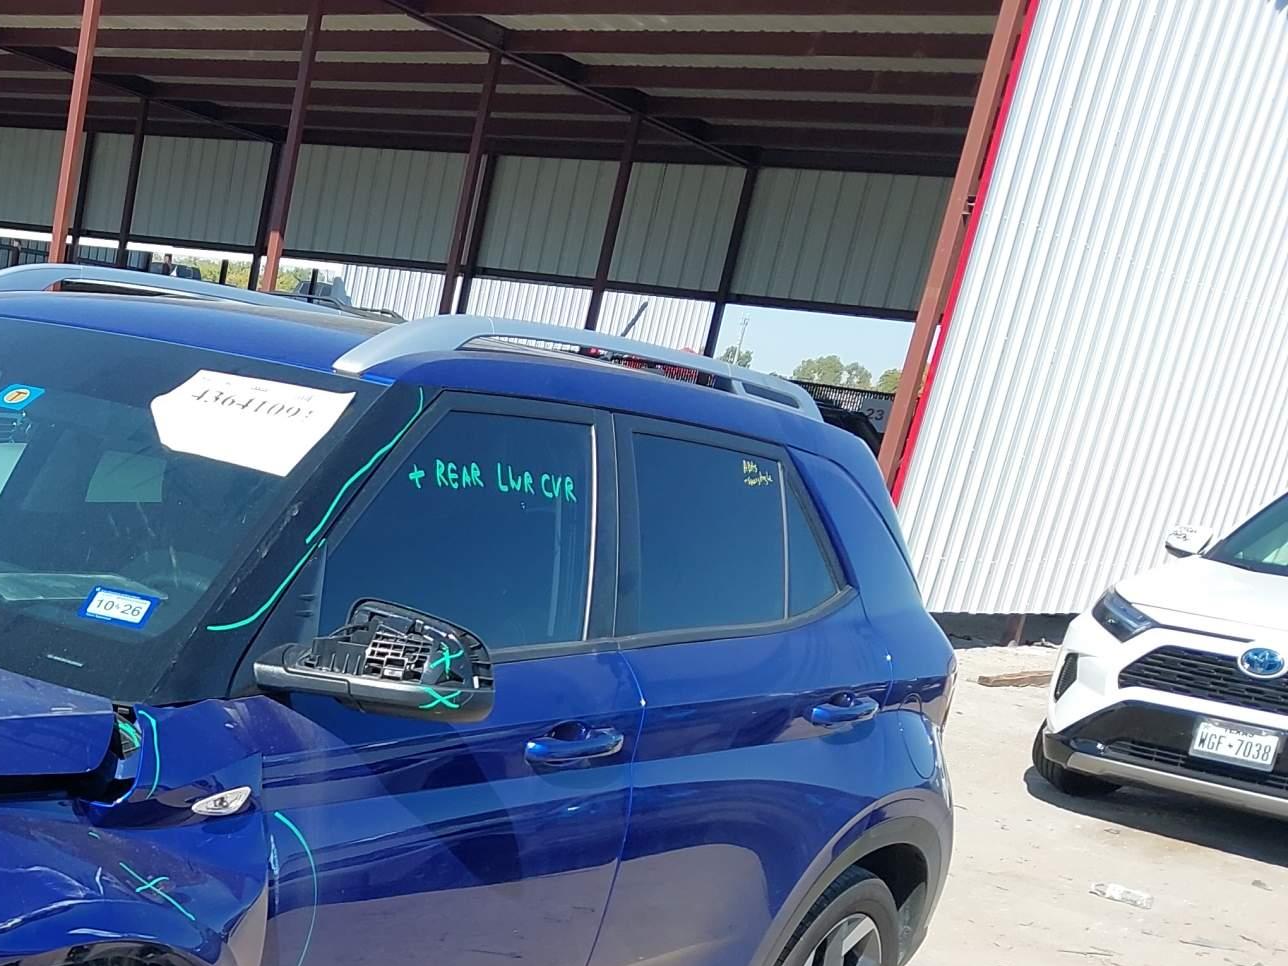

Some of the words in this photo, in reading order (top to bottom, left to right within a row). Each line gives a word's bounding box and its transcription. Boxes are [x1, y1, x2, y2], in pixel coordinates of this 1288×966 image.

[866, 408, 885, 421] 23
[435, 459, 484, 489] REAR
[496, 463, 535, 495] LWR
[541, 473, 577, 503] CVR
